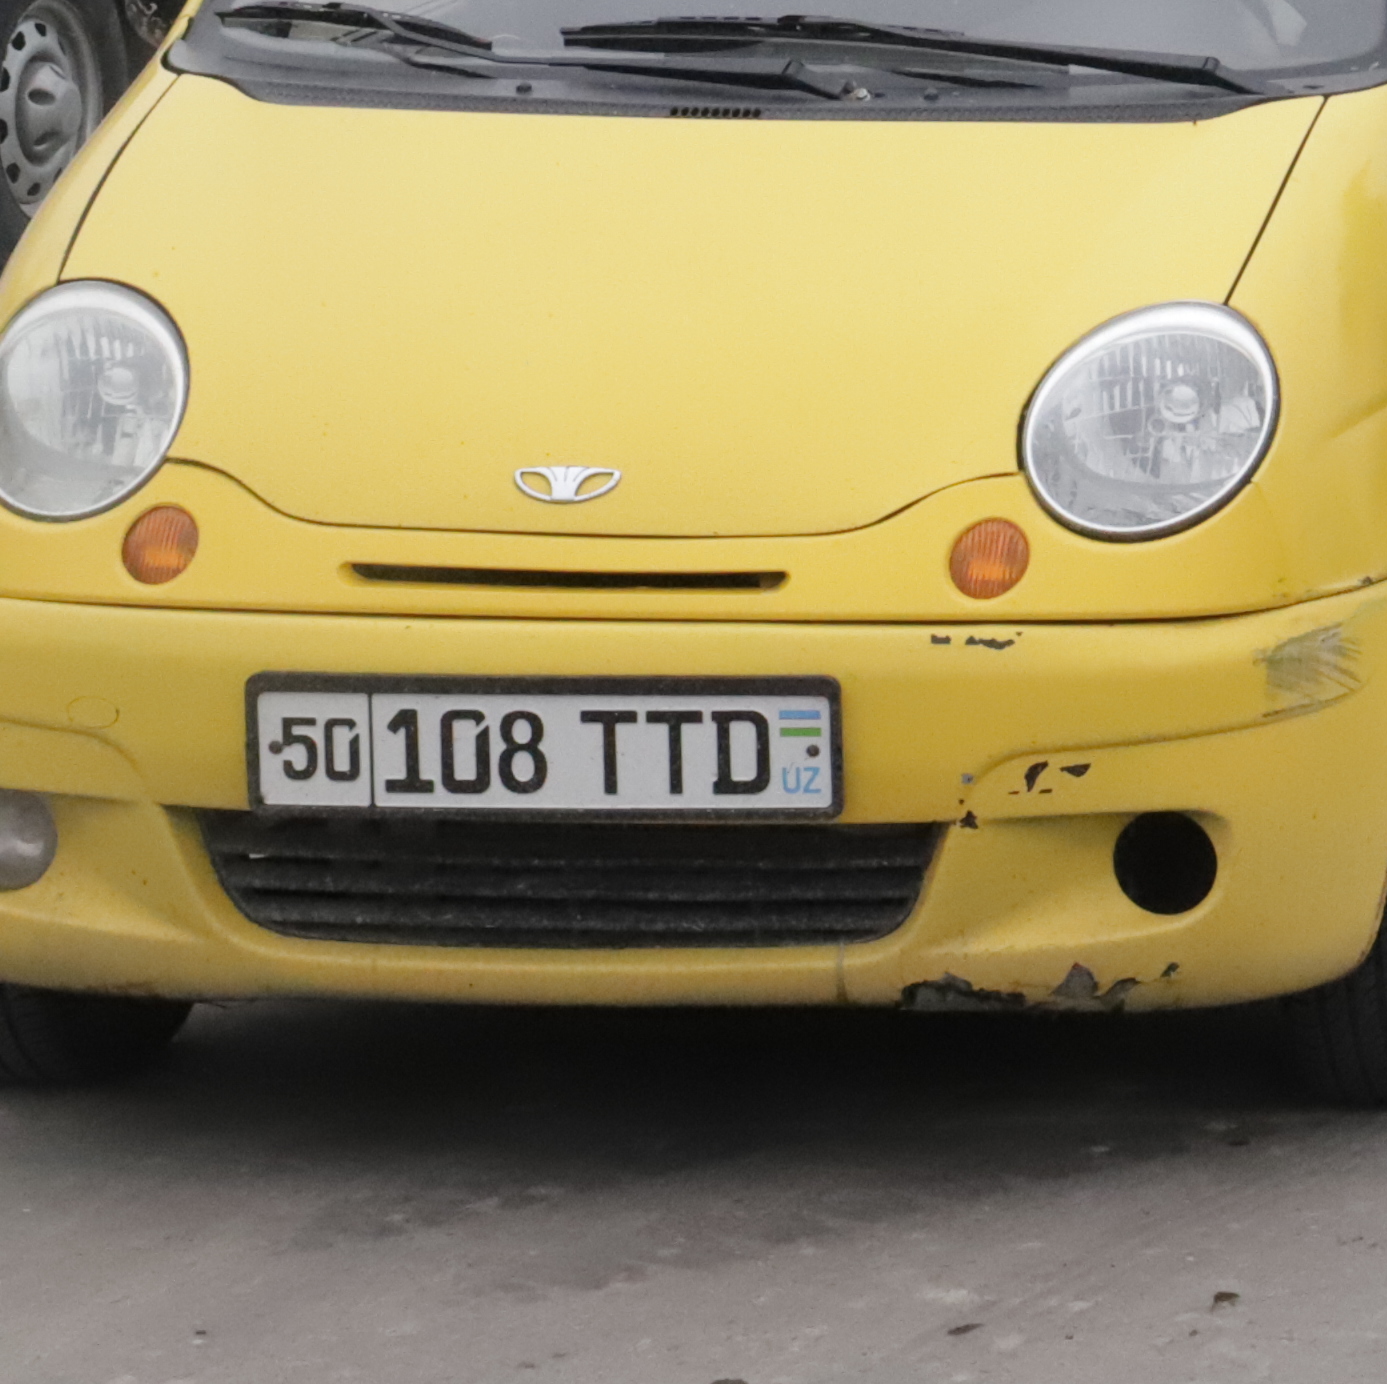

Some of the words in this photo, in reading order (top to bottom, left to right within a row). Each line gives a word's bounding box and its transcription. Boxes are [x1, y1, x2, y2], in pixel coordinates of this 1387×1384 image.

[281, 716, 361, 782] 50
[384, 708, 549, 795] 108
[579, 709, 771, 795] TTD
[780, 765, 822, 794] UZ
